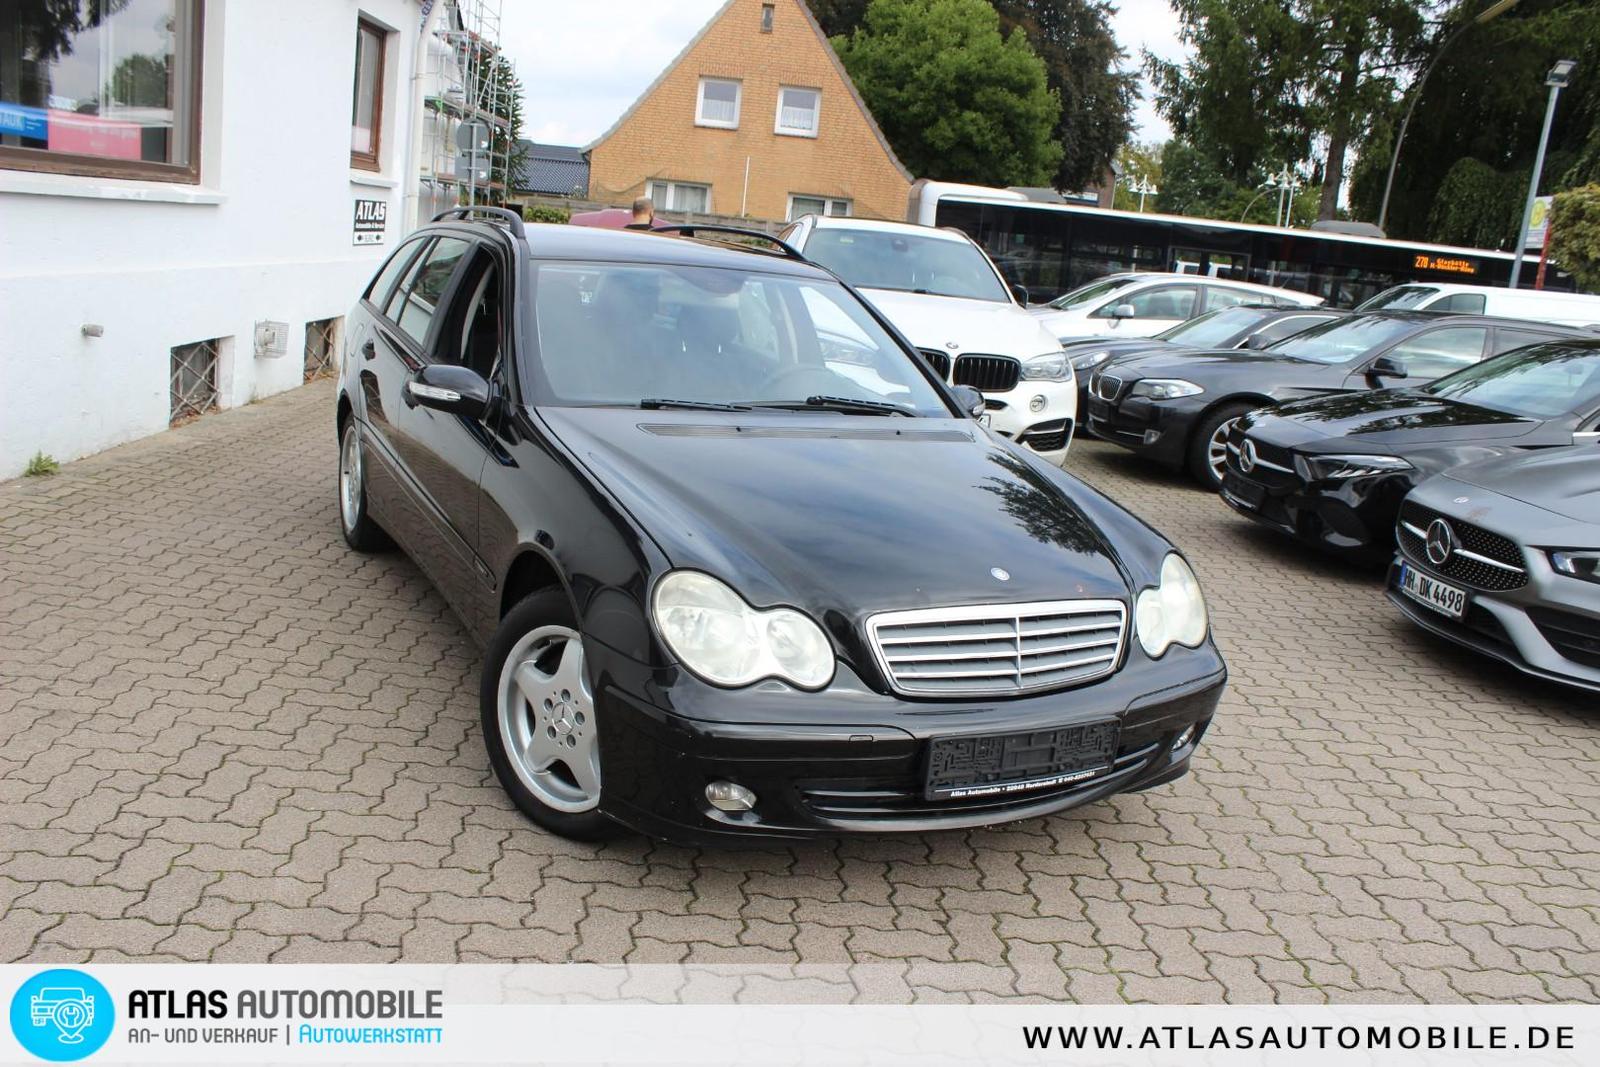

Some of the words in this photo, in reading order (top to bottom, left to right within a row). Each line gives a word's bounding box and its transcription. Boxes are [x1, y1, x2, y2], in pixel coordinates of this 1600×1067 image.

[355, 200, 386, 220] ATLAS
[1420, 576, 1433, 600] DK
[1433, 584, 1464, 612] 4498
